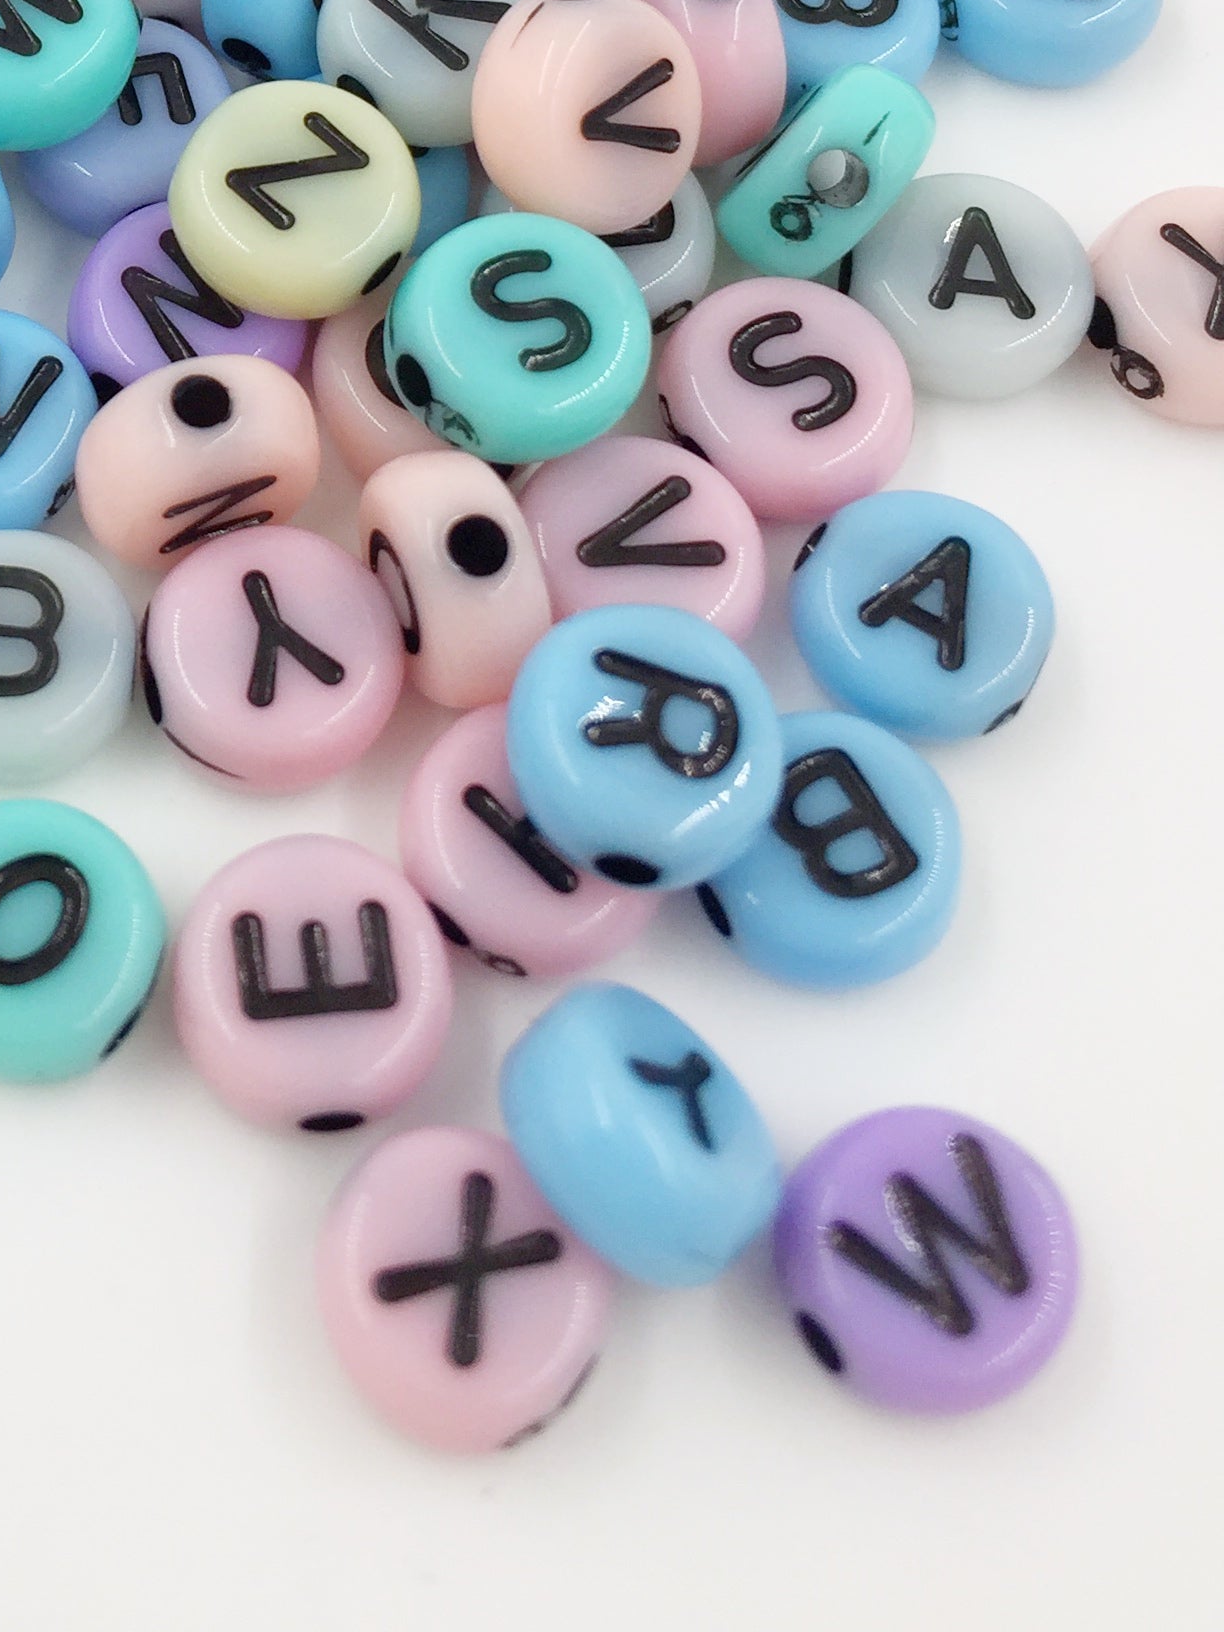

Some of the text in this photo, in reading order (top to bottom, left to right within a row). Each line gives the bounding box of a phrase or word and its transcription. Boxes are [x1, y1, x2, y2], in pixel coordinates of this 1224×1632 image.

[581, 58, 681, 154] V
[470, 249, 593, 373] S
[927, 206, 1037, 320] A
[728, 310, 858, 432] S
[575, 475, 726, 569] V
[242, 570, 345, 708] Y
[858, 536, 972, 672] A
[584, 649, 740, 780] R
[771, 748, 919, 899] B
[232, 901, 399, 1022] E
[374, 1171, 568, 1369] X
[829, 1136, 1032, 1339] W
